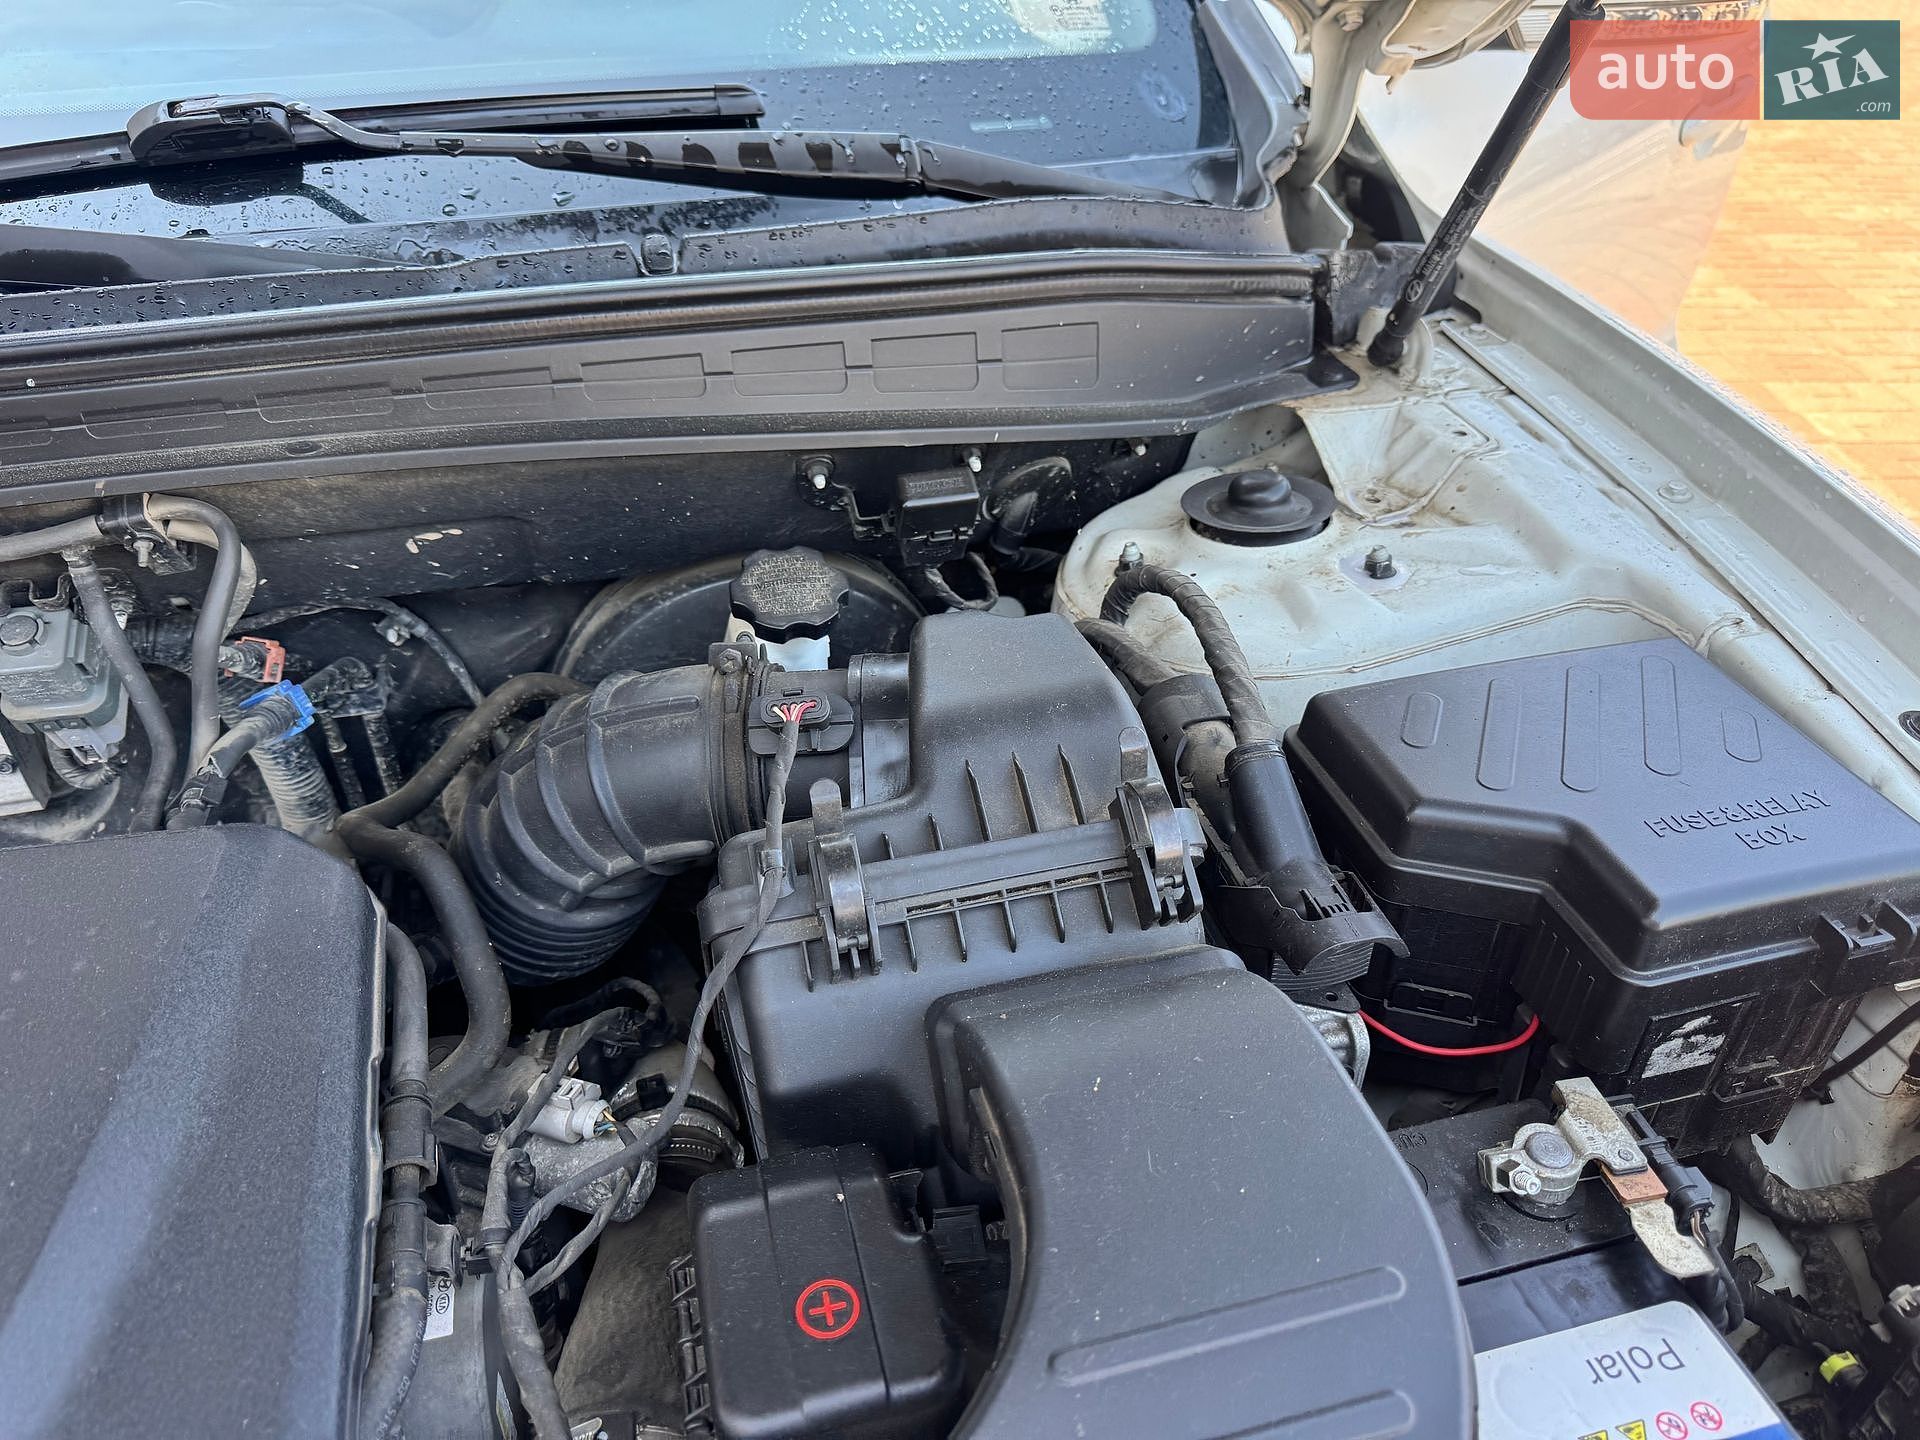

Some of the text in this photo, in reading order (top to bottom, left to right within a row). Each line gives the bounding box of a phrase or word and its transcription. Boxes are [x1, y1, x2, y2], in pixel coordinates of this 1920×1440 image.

[1643, 789, 1831, 838] FUSE&RELAY
[1735, 823, 1807, 850] BOX
[1585, 1337, 1686, 1385] Polar
